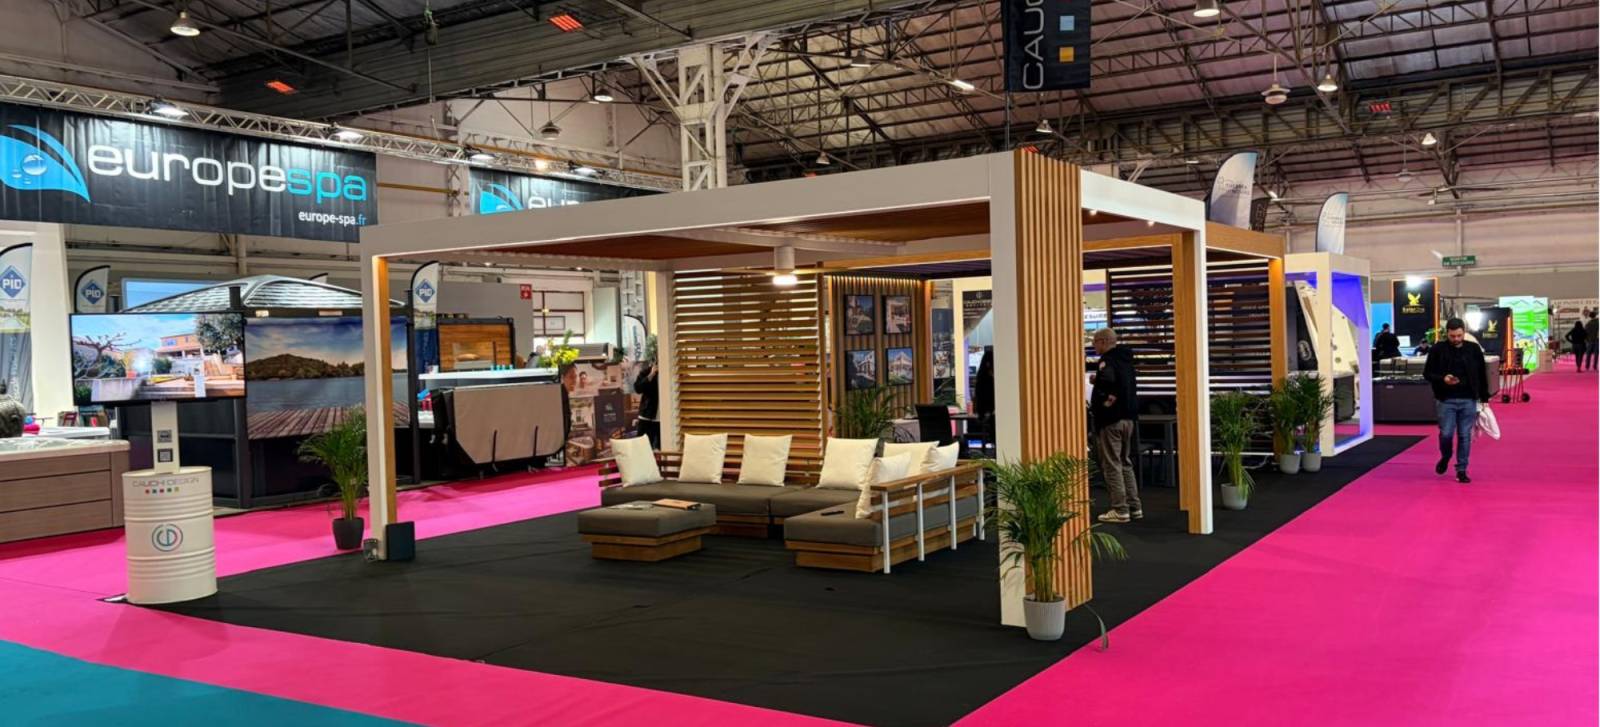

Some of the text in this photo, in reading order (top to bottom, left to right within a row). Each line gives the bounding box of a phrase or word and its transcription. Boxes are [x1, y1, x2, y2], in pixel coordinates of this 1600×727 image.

[1023, 0, 1044, 89] CAU
[298, 211, 366, 227] europe-spa.fr
[2, 278, 22, 289] PID
